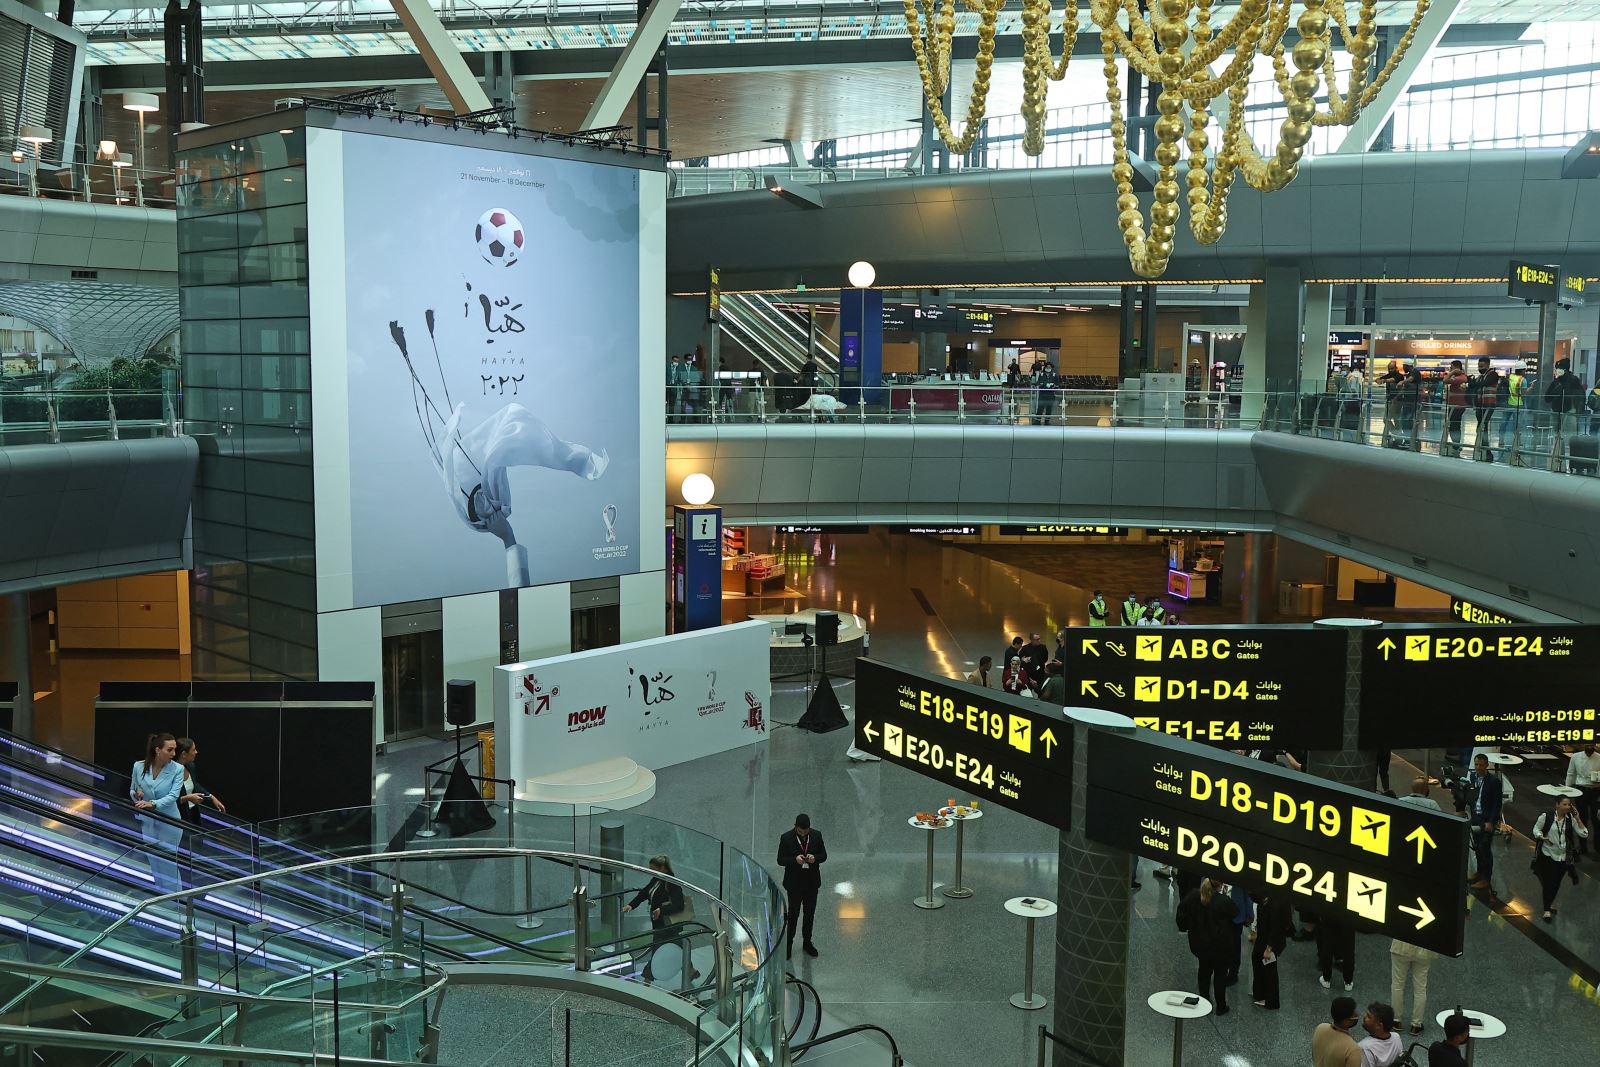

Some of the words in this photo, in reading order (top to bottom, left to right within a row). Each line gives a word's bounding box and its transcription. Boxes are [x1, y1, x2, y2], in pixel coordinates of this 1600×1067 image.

[460, 172, 468, 180] 21
[468, 173, 500, 184] November
[507, 177, 514, 185] 18
[514, 178, 546, 189] December
[481, 357, 525, 366] HAYYA
[1471, 607, 1512, 625] E20-E
[1236, 639, 1263, 650] بوابات
[1435, 636, 1544, 659] E20-E24
[1549, 636, 1574, 646] بوابات
[1236, 652, 1260, 660] Gates
[1549, 648, 1571, 656] Gates
[1166, 679, 1250, 701] D1-D4
[1255, 680, 1282, 691] بوابات
[897, 685, 917, 700] بوابات
[1255, 693, 1279, 701] Gates
[899, 699, 916, 711] Gates
[567, 705, 608, 726] now
[920, 690, 1004, 740] E18-E19
[1473, 714, 1494, 722] Gates
[1500, 712, 1524, 723] بوابات
[1525, 709, 1582, 722] D18-D19
[639, 719, 670, 732] HAYYA
[1248, 721, 1274, 732] بوابات
[1248, 733, 1271, 741] Gates
[1474, 734, 1497, 742] Gates
[1501, 732, 1526, 743] بوابات
[1526, 729, 1581, 742] E18-E19
[906, 734, 995, 789] E20-E24
[1152, 762, 1183, 780] بوابات
[999, 770, 1022, 787] بوابات
[999, 785, 1019, 800] Gates
[1155, 780, 1182, 795] Gates
[1190, 769, 1341, 838] D18-D19
[1140, 817, 1170, 837] بوابات
[1142, 835, 1169, 851] Gates
[1176, 826, 1337, 903] D20-D24
